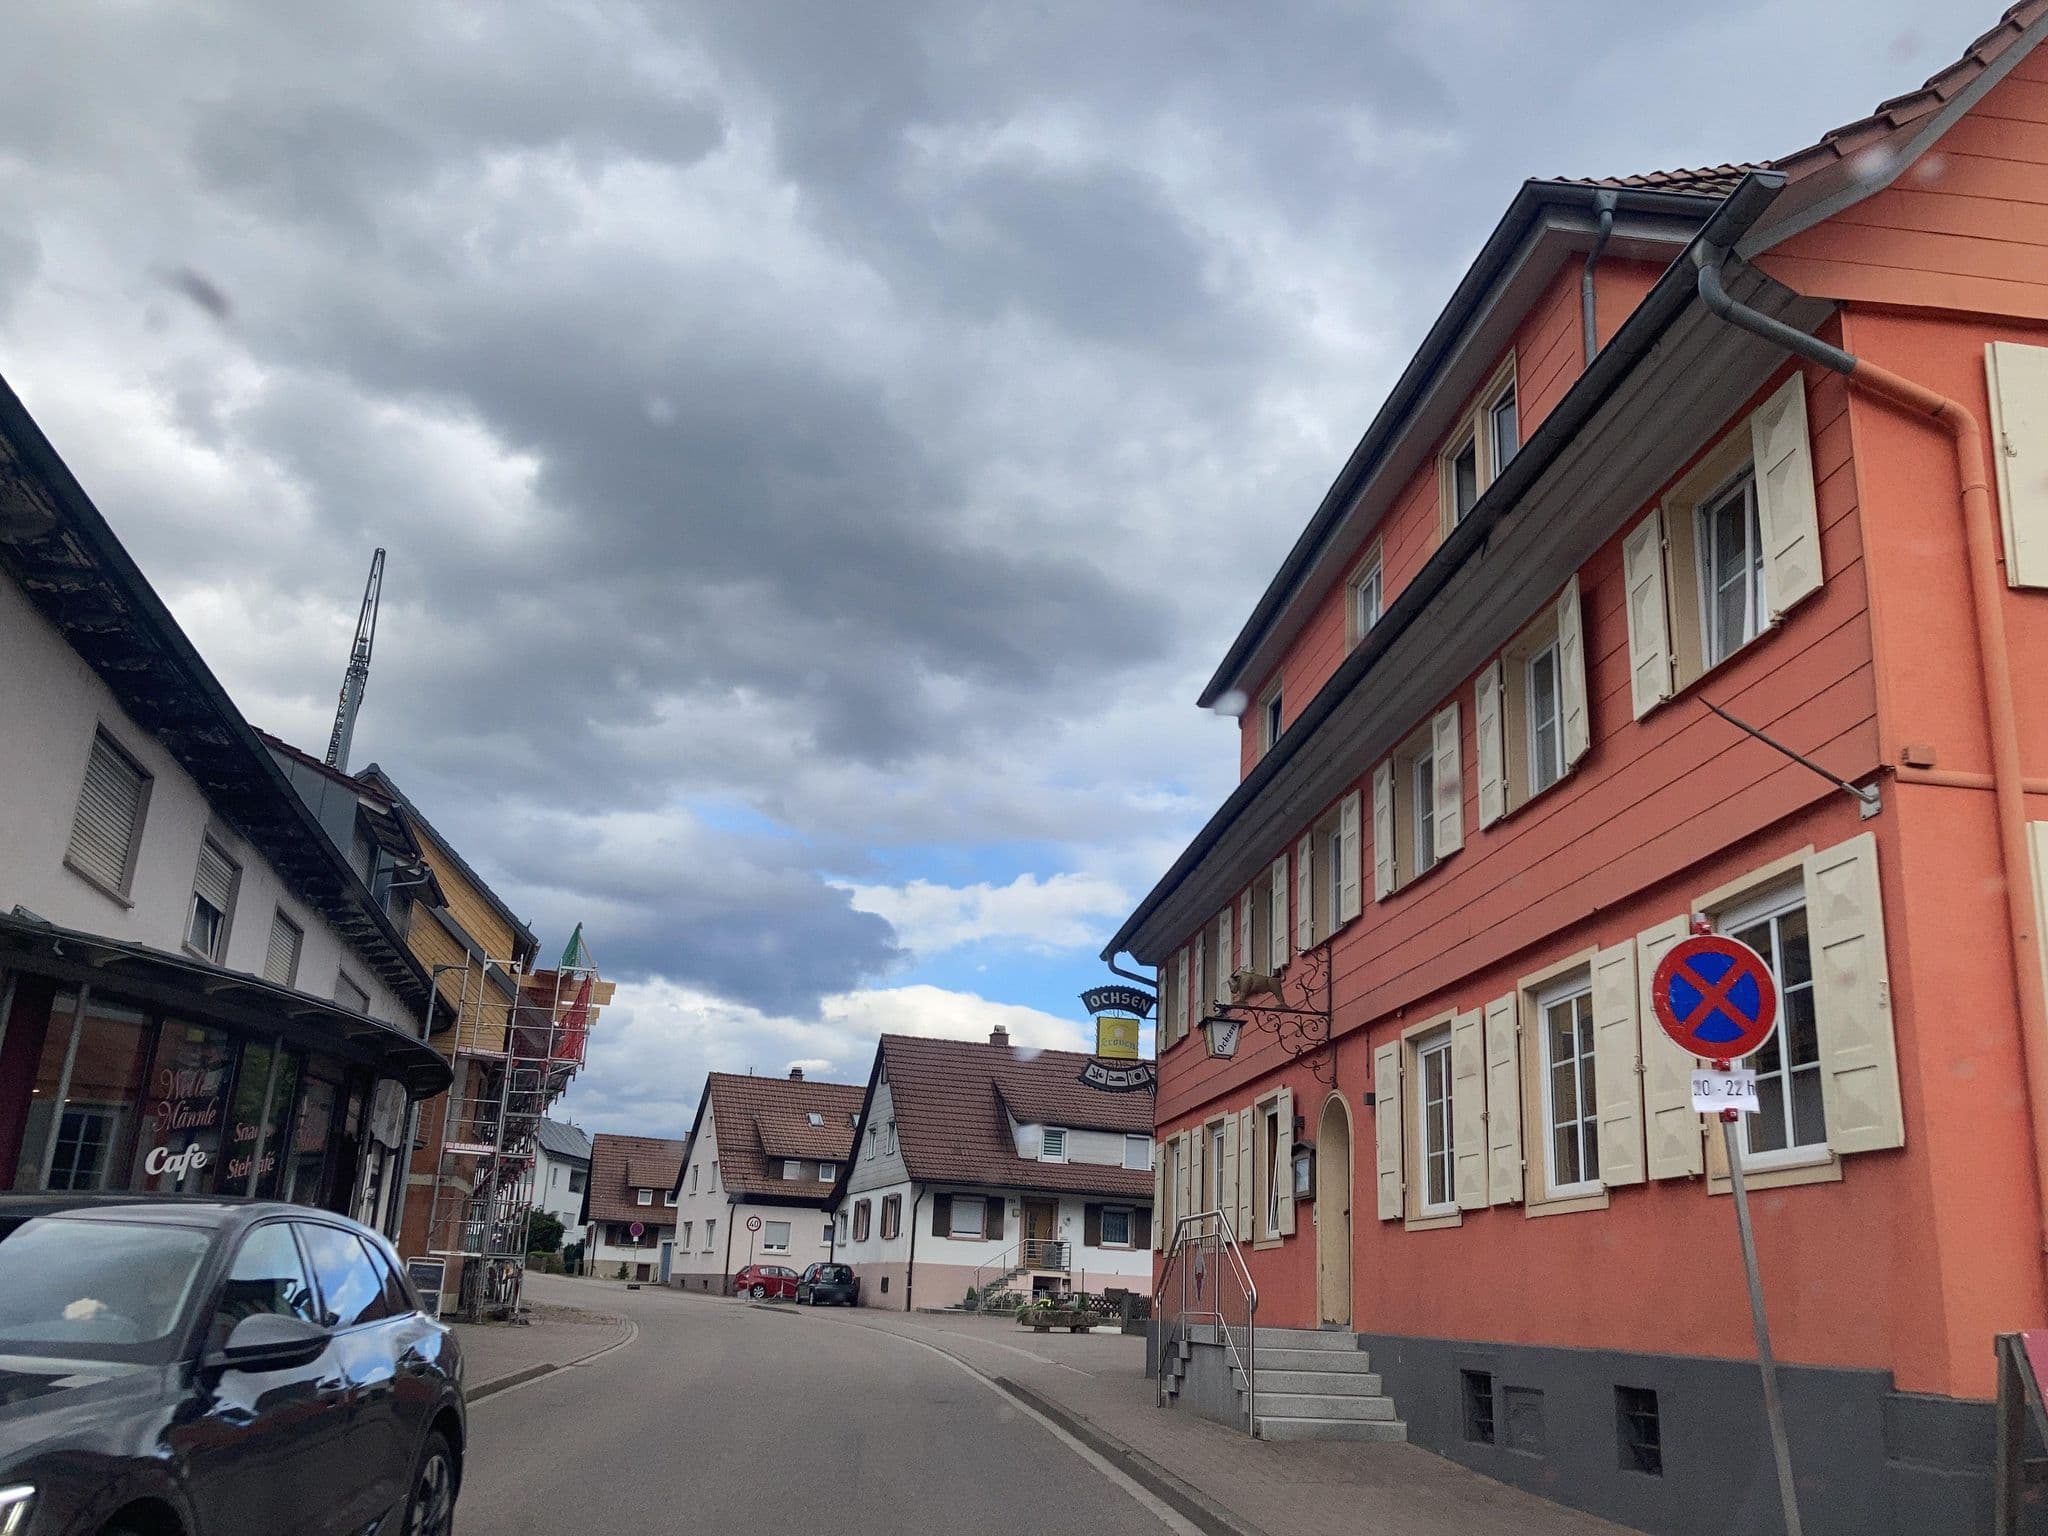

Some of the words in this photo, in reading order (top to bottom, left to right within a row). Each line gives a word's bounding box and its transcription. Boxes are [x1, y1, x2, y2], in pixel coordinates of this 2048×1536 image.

[1090, 991, 1151, 1012] OCHSEN
[1725, 1079, 1743, 1096] 22
[1747, 1079, 1756, 1096] h
[144, 1143, 208, 1181] Cafe
